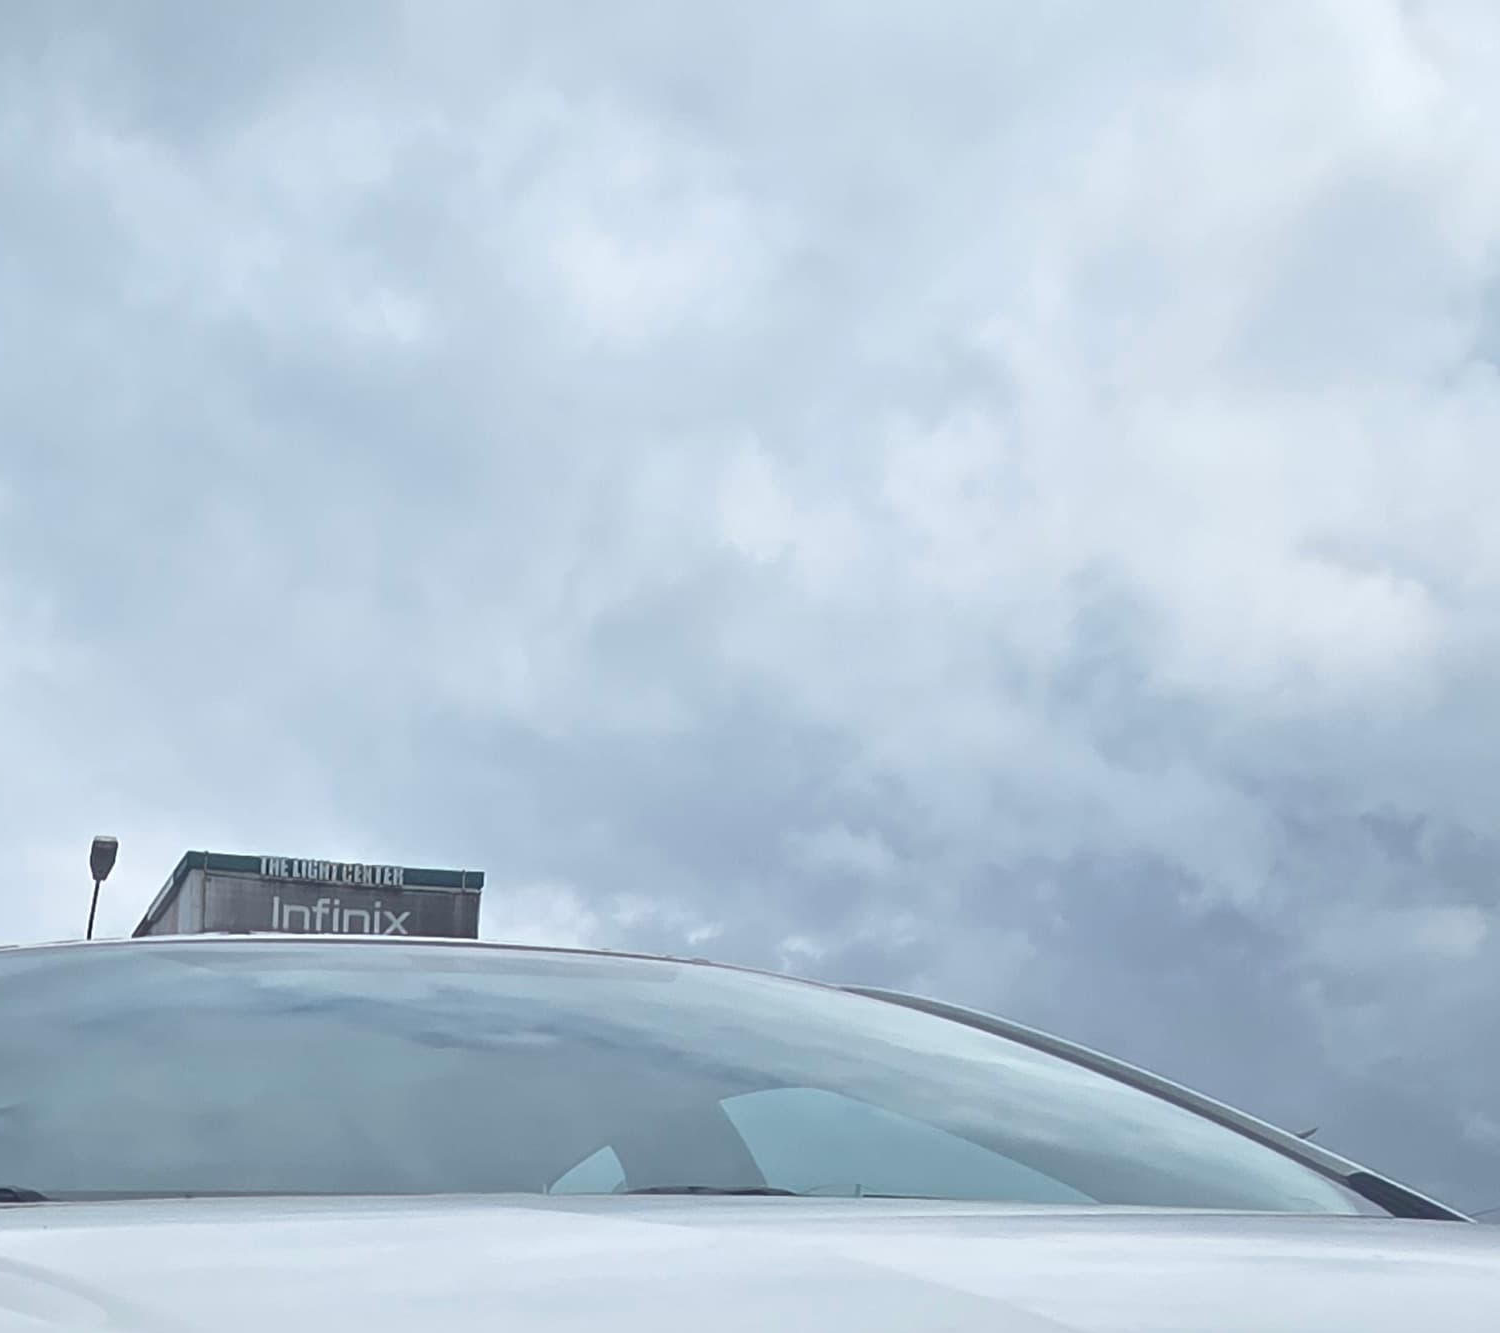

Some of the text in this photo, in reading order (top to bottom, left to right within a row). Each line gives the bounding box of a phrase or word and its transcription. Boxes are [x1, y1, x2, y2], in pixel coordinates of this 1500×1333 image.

[260, 856, 405, 887] THE LIGHT CENTER
[271, 895, 412, 936] Infinix
